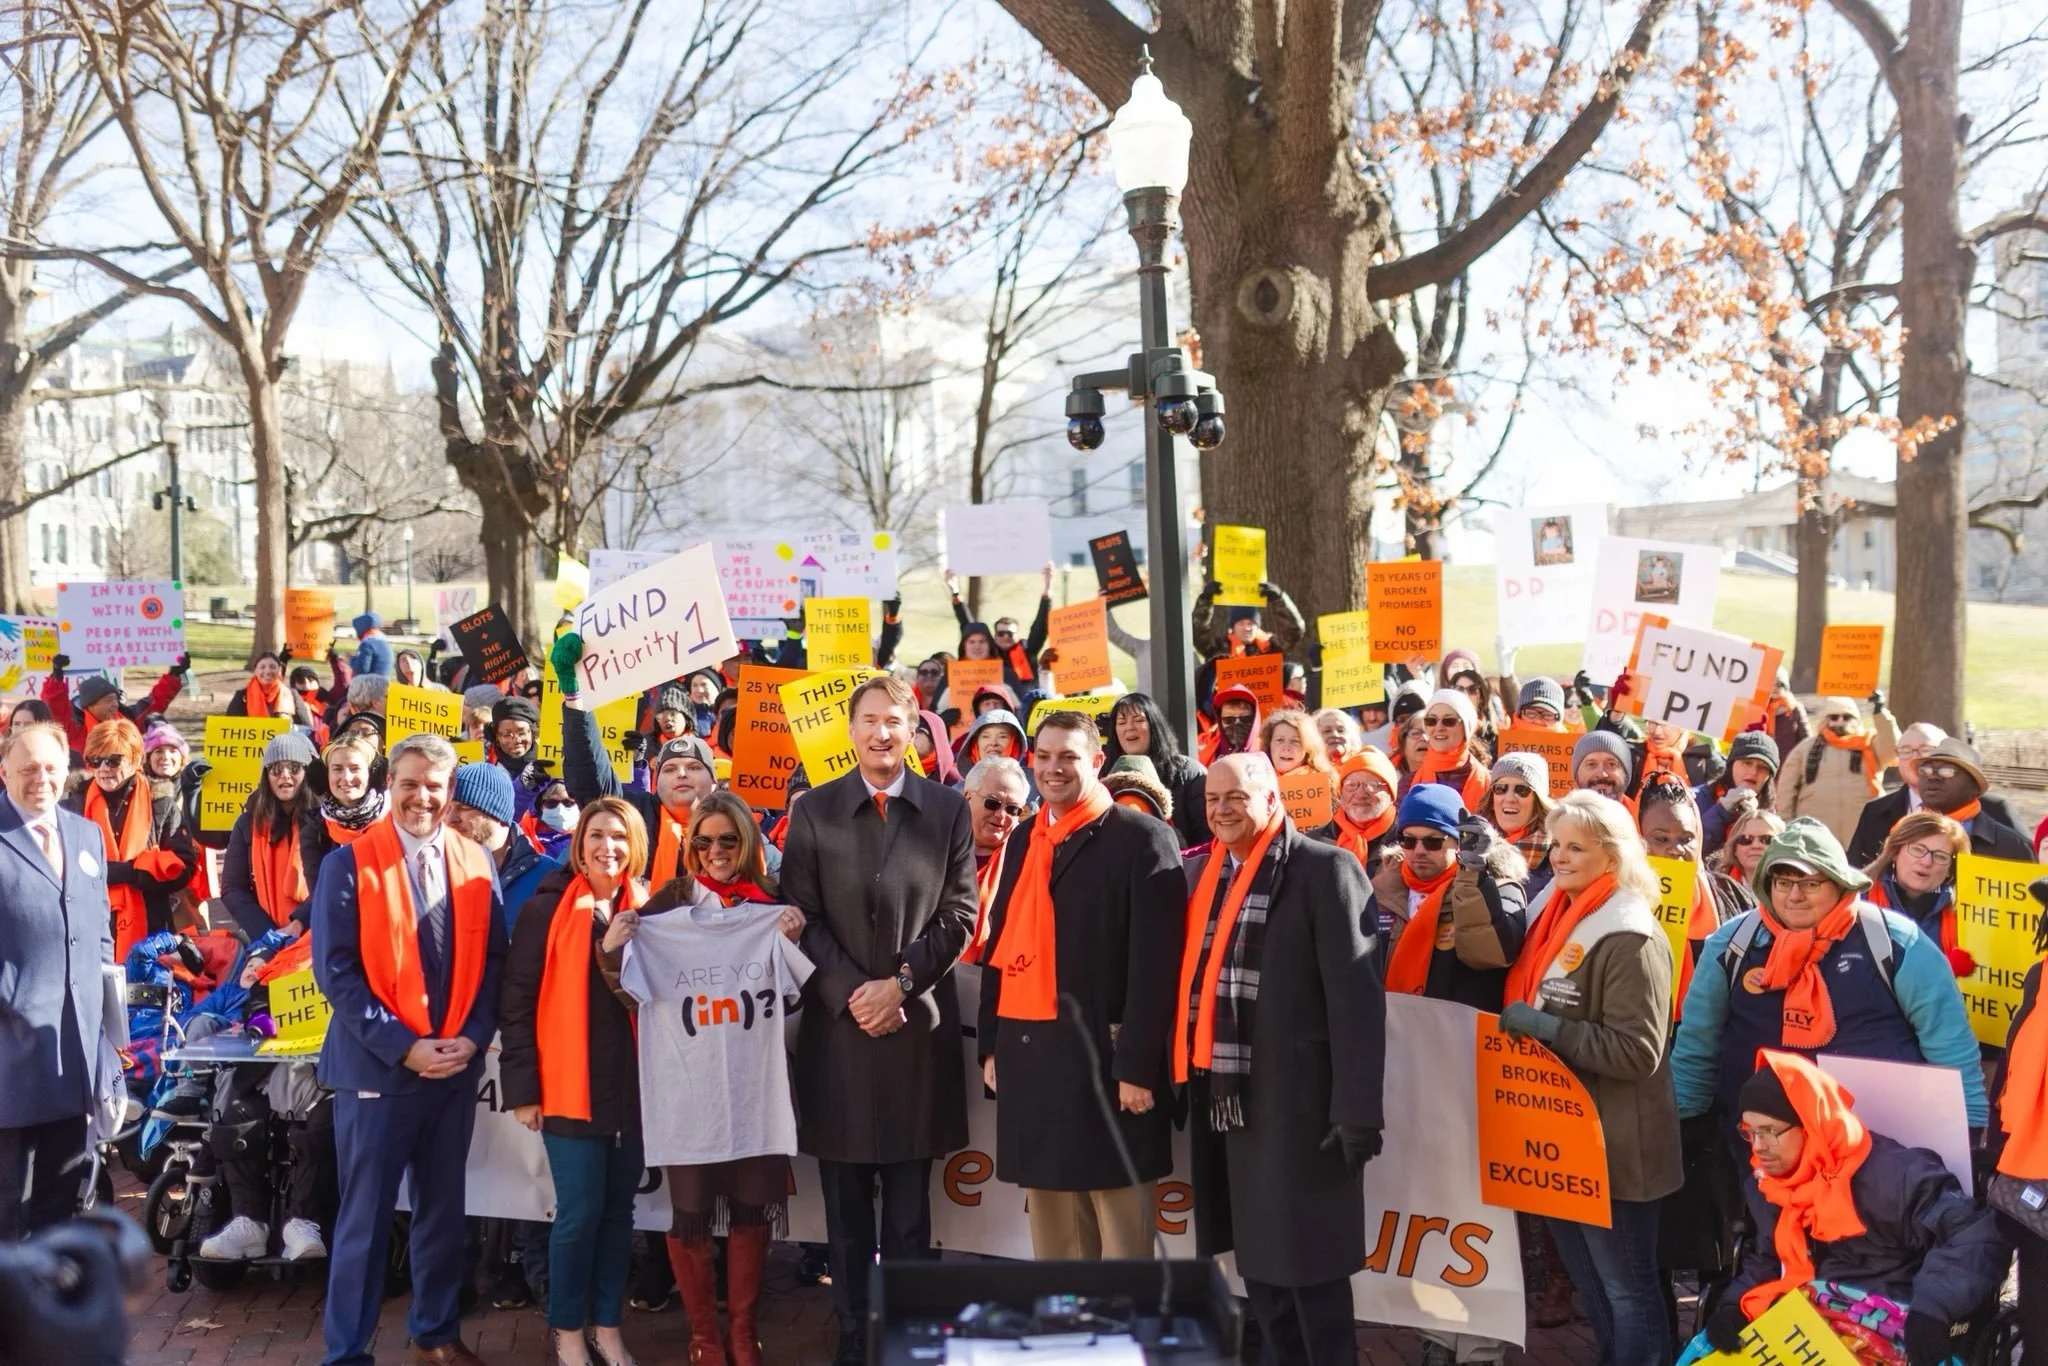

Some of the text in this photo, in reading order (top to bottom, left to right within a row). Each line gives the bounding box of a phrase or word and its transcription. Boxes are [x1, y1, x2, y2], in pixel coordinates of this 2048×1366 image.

[1374, 571, 1438, 582] 25 YEARS OF
[91, 585, 157, 597] INVEST
[1384, 586, 1427, 596] BROKEN
[93, 604, 134, 617] WITH
[1380, 600, 1432, 609] PROMISES
[817, 608, 859, 618] THIS IS
[1064, 610, 1088, 621] YEARS
[461, 611, 493, 632] SLOTS
[809, 623, 869, 633] THE TIME!
[1060, 621, 1093, 633] BROKEN
[1330, 622, 1357, 634] THIS
[137, 626, 172, 637] WITH
[1396, 625, 1416, 636] NO
[1056, 632, 1098, 644] PROMISES
[482, 642, 501, 656] THE
[582, 601, 720, 691] Priority 1
[1323, 639, 1346, 651] THE
[1374, 640, 1438, 651] EXCUSES!
[28, 655, 53, 664] MON
[108, 656, 149, 667] 2024
[484, 649, 510, 670] RIGHT
[819, 654, 860, 664] THIS IS
[1072, 656, 1088, 666] NO
[1222, 665, 1278, 680] 25 YEARS OF
[1335, 664, 1373, 679] THIS IS
[1842, 671, 1858, 680] NO
[746, 682, 762, 693] 25
[800, 679, 846, 705] THIS
[1245, 681, 1269, 690] OKEN
[1325, 684, 1346, 696] THE
[400, 697, 448, 717] THIS IS
[1663, 691, 1713, 731] P1
[389, 714, 416, 731] THE
[751, 720, 791, 733] PROM
[792, 707, 833, 733] THE
[221, 728, 276, 741] THIS IS
[602, 726, 616, 740] IS
[207, 746, 238, 758] THE
[543, 745, 564, 758] TH
[1505, 743, 1575, 756] 25 YEARS O
[769, 756, 796, 771] NO
[824, 749, 858, 772] THI
[218, 782, 252, 794] THIS
[738, 775, 785, 790] EXCU
[1280, 788, 1323, 801] ARS OF
[205, 802, 235, 814] THE
[1286, 808, 1312, 820] KEN
[1660, 876, 1672, 894] S
[1975, 876, 2027, 901] THIS
[1653, 904, 1686, 925] ME!
[1960, 903, 1999, 927] THE
[675, 965, 724, 990] ARE
[1975, 964, 2024, 990] THIS
[288, 982, 315, 1002] TH
[1962, 992, 1999, 1018] THE
[275, 1004, 316, 1028] THE
[1785, 1011, 1815, 1026] LLY
[1484, 1035, 1502, 1052] 25
[1502, 1064, 1571, 1090] BROKEN
[1495, 1088, 1584, 1118] PROMISES
[1525, 1139, 1560, 1162] NO
[1489, 1162, 1601, 1199] EXCUSES!
[1364, 1210, 1493, 1287] urs
